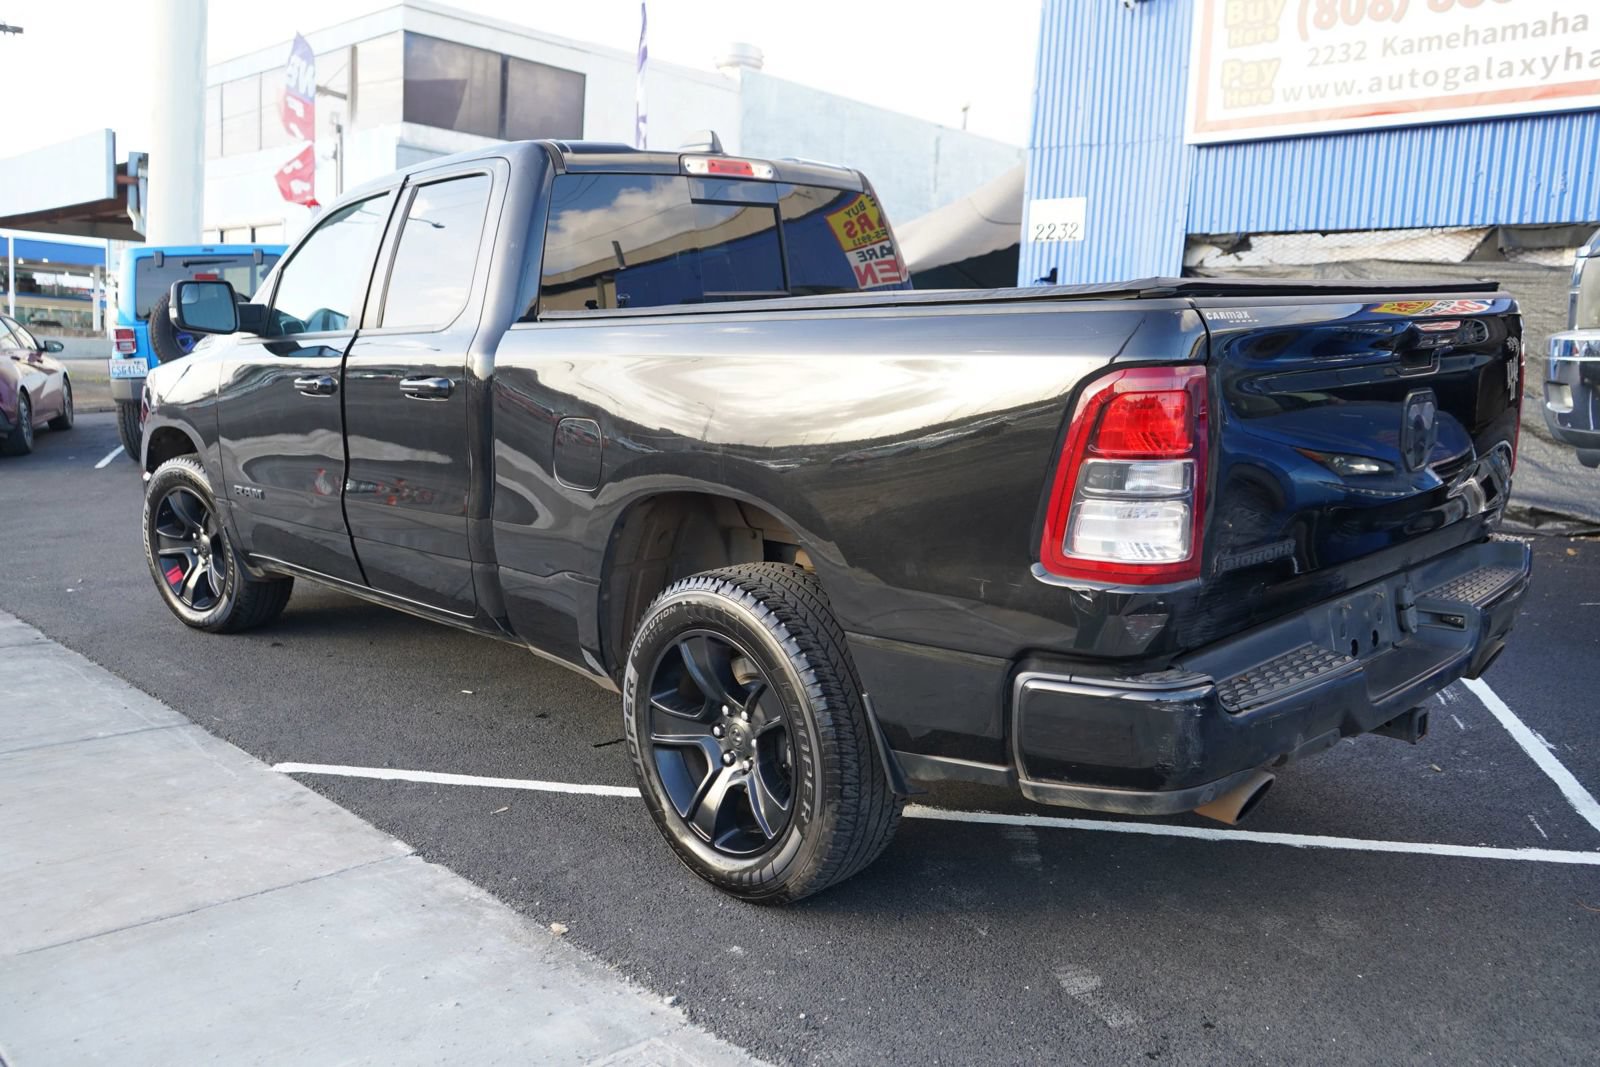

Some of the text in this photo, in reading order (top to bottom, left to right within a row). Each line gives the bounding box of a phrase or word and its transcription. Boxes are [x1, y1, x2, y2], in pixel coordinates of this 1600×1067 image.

[1224, 0, 1286, 28] Buy
[1228, 26, 1279, 48] Here
[1307, 11, 1589, 67] 2232 Kamehamaha
[1221, 58, 1282, 90] Pay
[1282, 46, 1600, 102] www.autogalaxyha
[1223, 87, 1275, 109] Here
[1034, 223, 1079, 241] 2232
[234, 484, 263, 499] RAM
[633, 605, 677, 656] EVOLUTION
